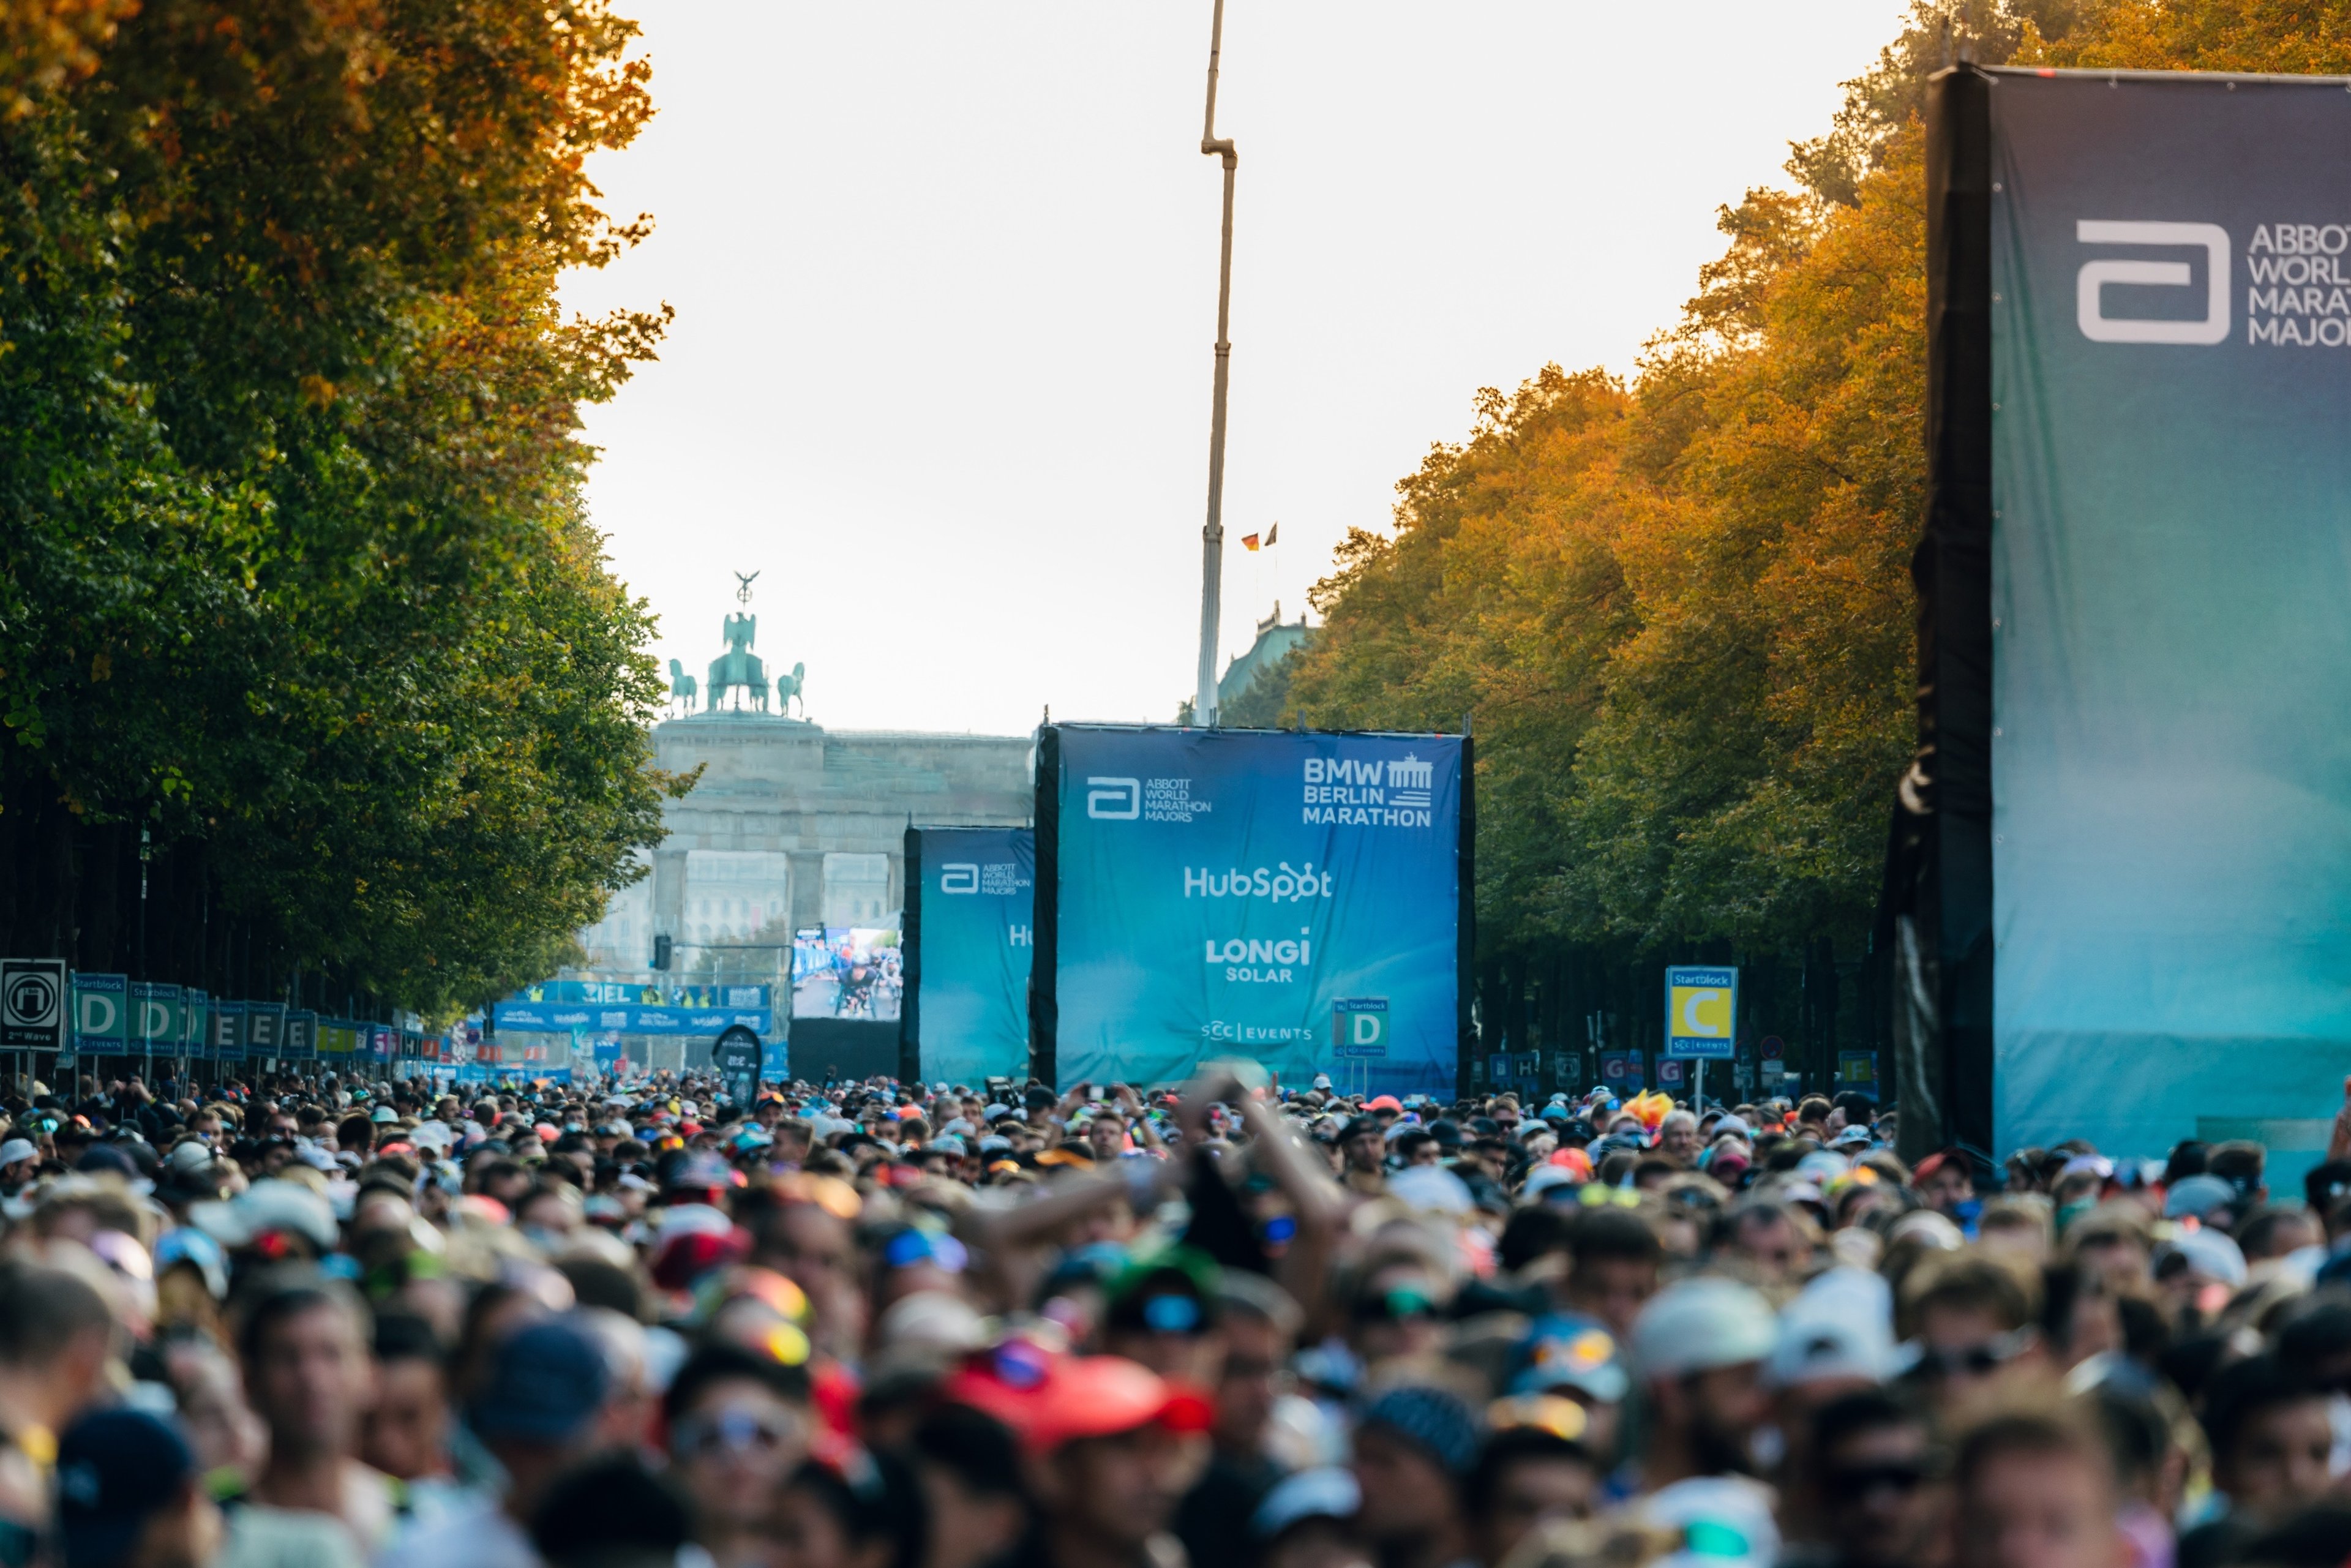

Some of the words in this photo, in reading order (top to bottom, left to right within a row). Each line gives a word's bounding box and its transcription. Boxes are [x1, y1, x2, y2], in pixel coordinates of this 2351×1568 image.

[2249, 223, 2351, 255] ABBO
[2248, 255, 2351, 285] WORL
[2248, 287, 2351, 316] MARA
[2248, 317, 2351, 347] MAJO
[1304, 758, 1383, 786] BMW
[1145, 778, 1191, 790] ABBOTT
[1145, 790, 1189, 800] WORLD
[1304, 785, 1384, 805] BERLIN
[1145, 800, 1212, 812] MARATHON
[1145, 811, 1193, 822] MAJORS
[1303, 807, 1431, 827] MARATHON
[982, 863, 1016, 872] ABBOTT
[981, 887, 1017, 895] MAJORS
[1184, 861, 1332, 903] HubSpot
[75, 979, 122, 990] Startblock
[1226, 967, 1293, 983] SOLAR
[1674, 974, 1728, 985] Startblock
[582, 983, 631, 1003] ZIEL
[81, 994, 116, 1034] D
[1349, 1002, 1386, 1010] Startblock
[1684, 991, 1719, 1035] C
[138, 1001, 170, 1038] D
[252, 1015, 271, 1044] E
[1354, 1014, 1381, 1045] D
[24, 1032, 51, 1041] Wave
[219, 1016, 234, 1046] E
[289, 1021, 305, 1047] E
[1245, 1027, 1313, 1040] EVENTS
[1519, 1061, 1532, 1076] H
[1606, 1059, 1624, 1078] G
[1661, 1061, 1680, 1082] G
[1850, 1060, 1863, 1080] F
